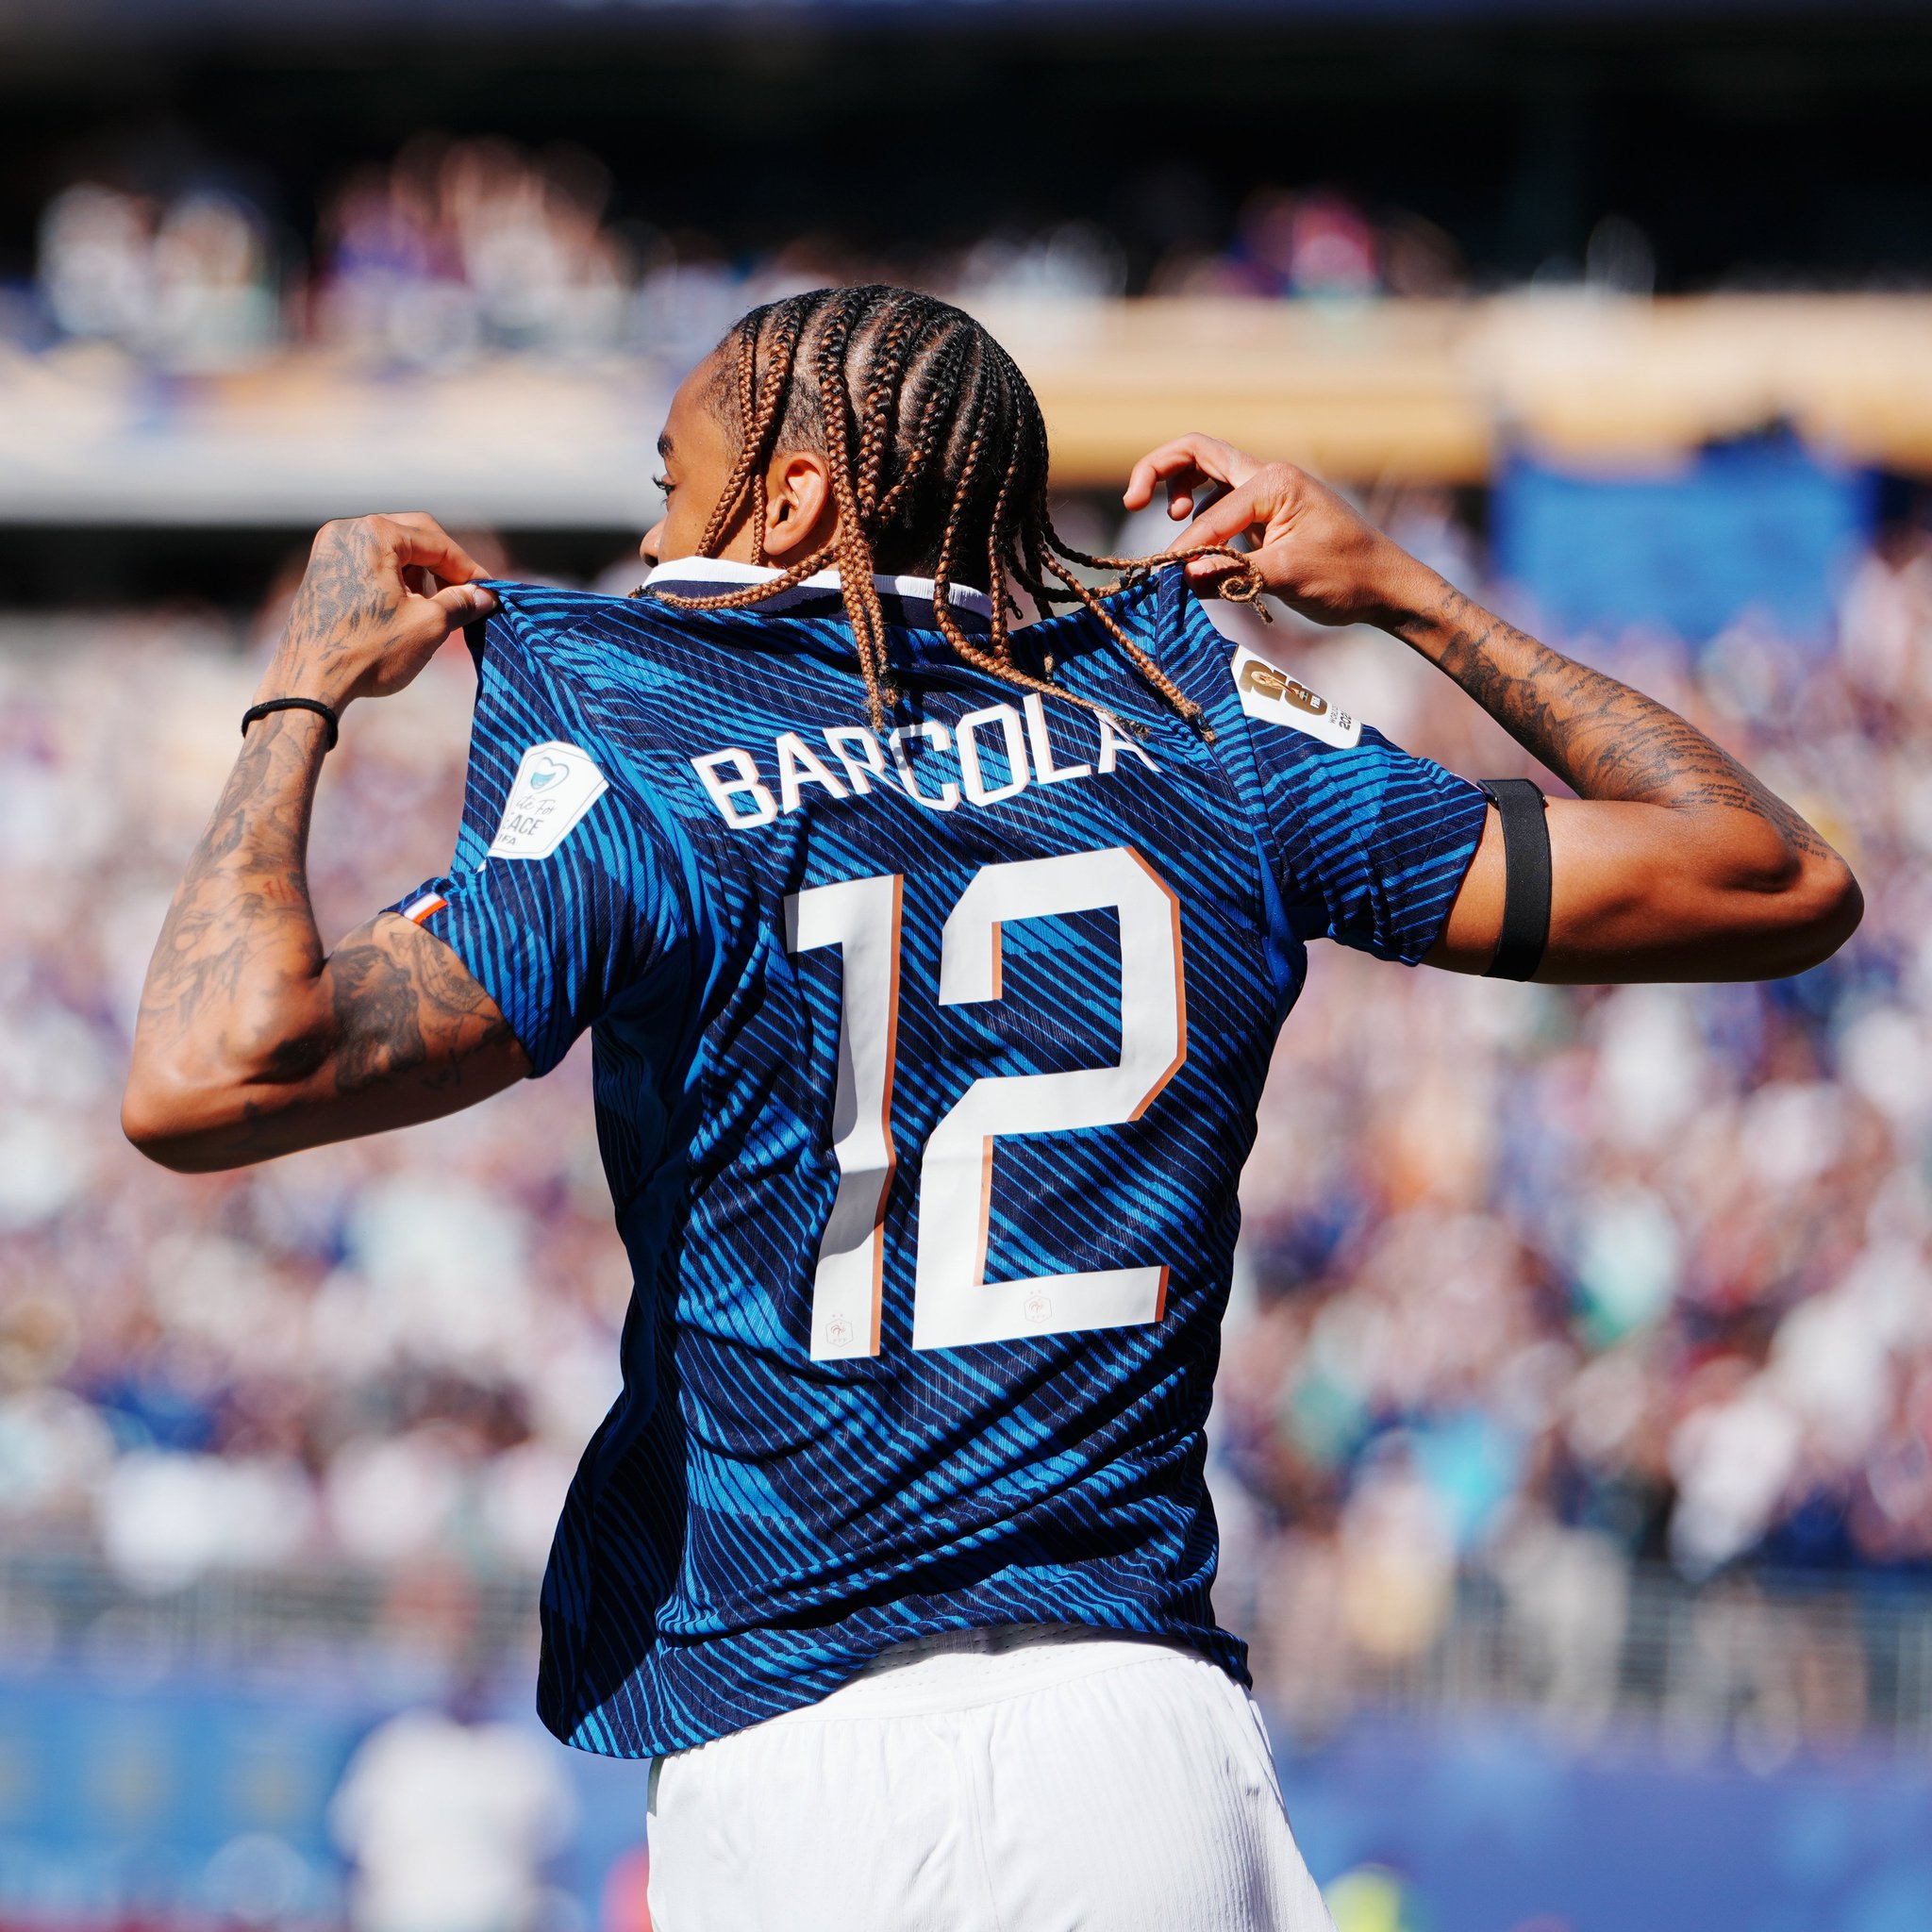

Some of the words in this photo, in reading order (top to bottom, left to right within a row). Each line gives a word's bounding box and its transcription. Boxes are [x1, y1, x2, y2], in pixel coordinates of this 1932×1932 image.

[691, 692, 1162, 830] BARCOLA
[496, 834, 517, 845] IFA
[503, 812, 544, 836] ACE
[784, 846, 1187, 1360] 12
